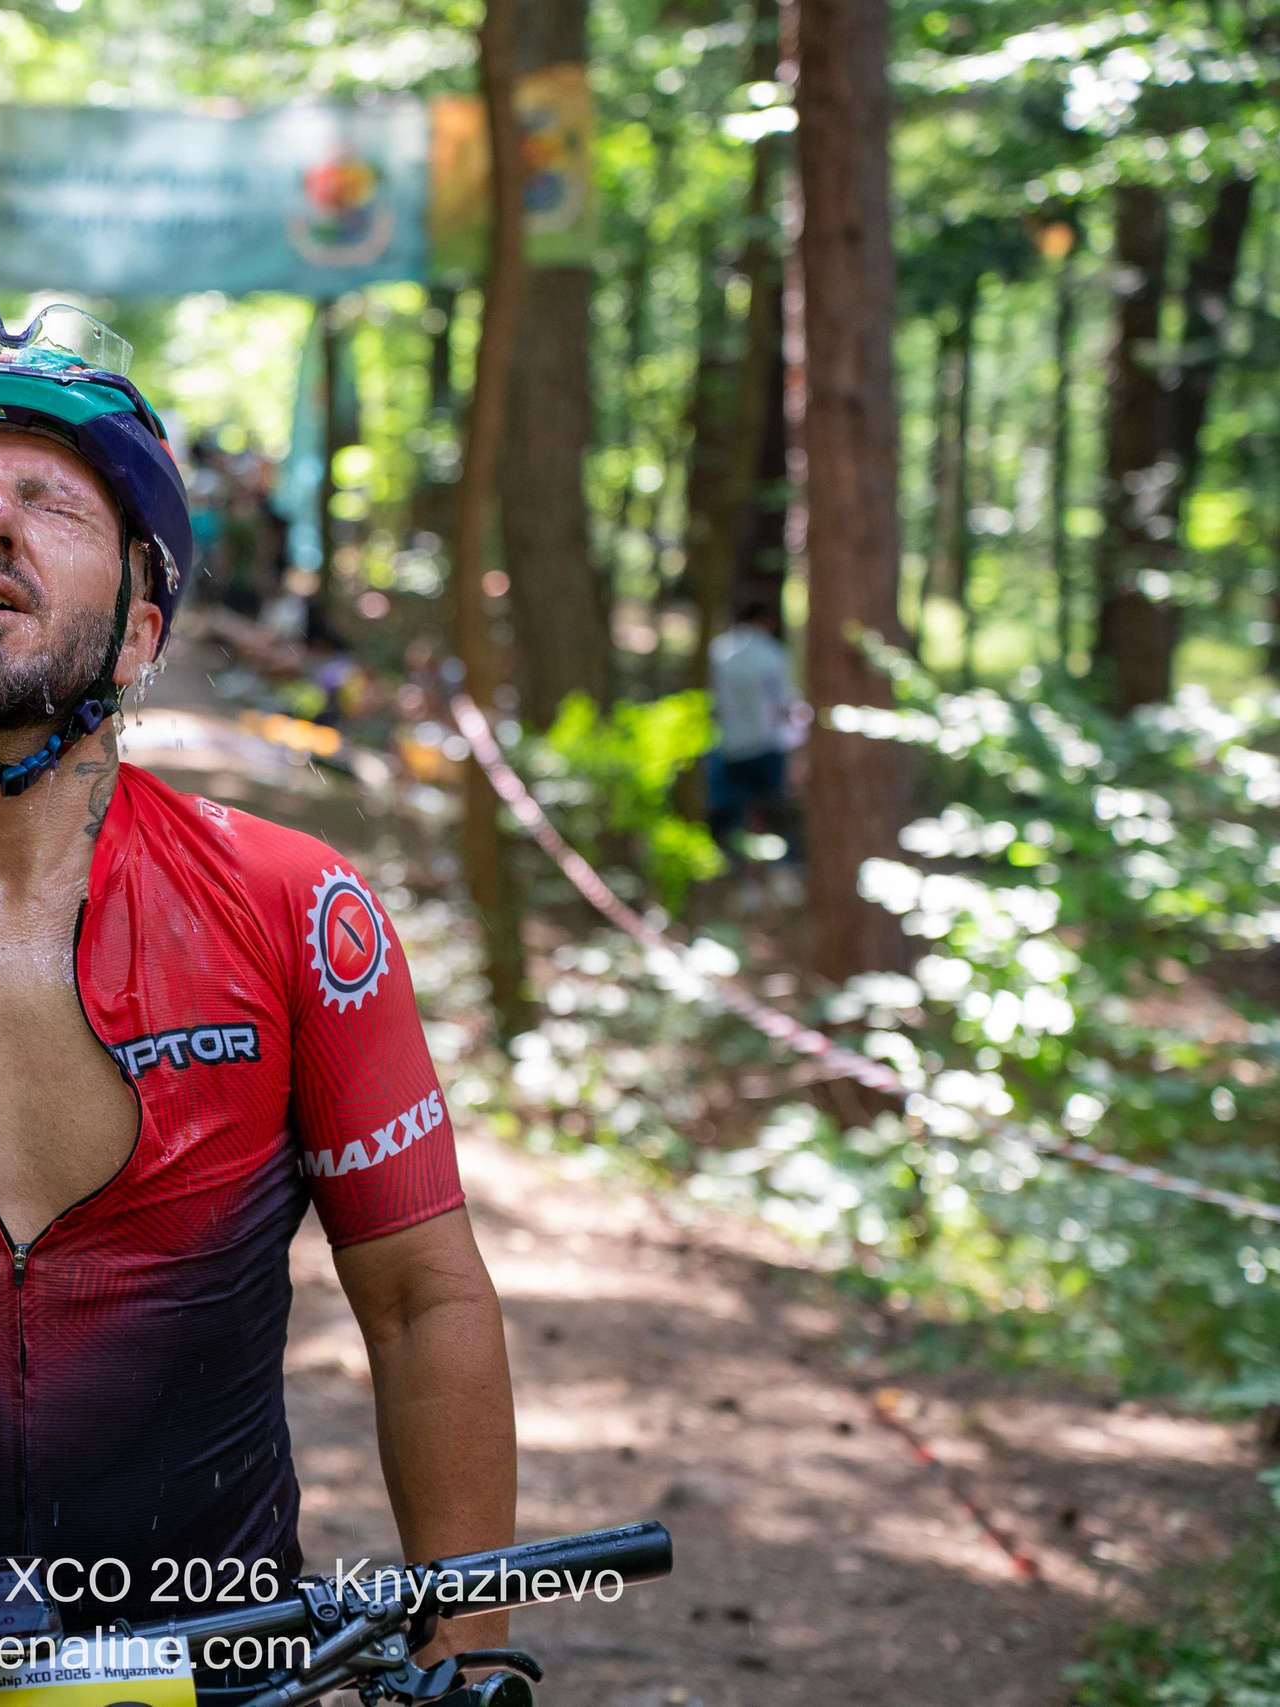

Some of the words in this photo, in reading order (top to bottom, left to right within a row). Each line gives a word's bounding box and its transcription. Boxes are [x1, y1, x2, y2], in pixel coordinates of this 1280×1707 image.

[114, 1026, 257, 1076] PTOR
[305, 1089, 444, 1178] MAXXIS
[25, 1671, 51, 1685] XCO
[55, 1667, 91, 1681] 2026
